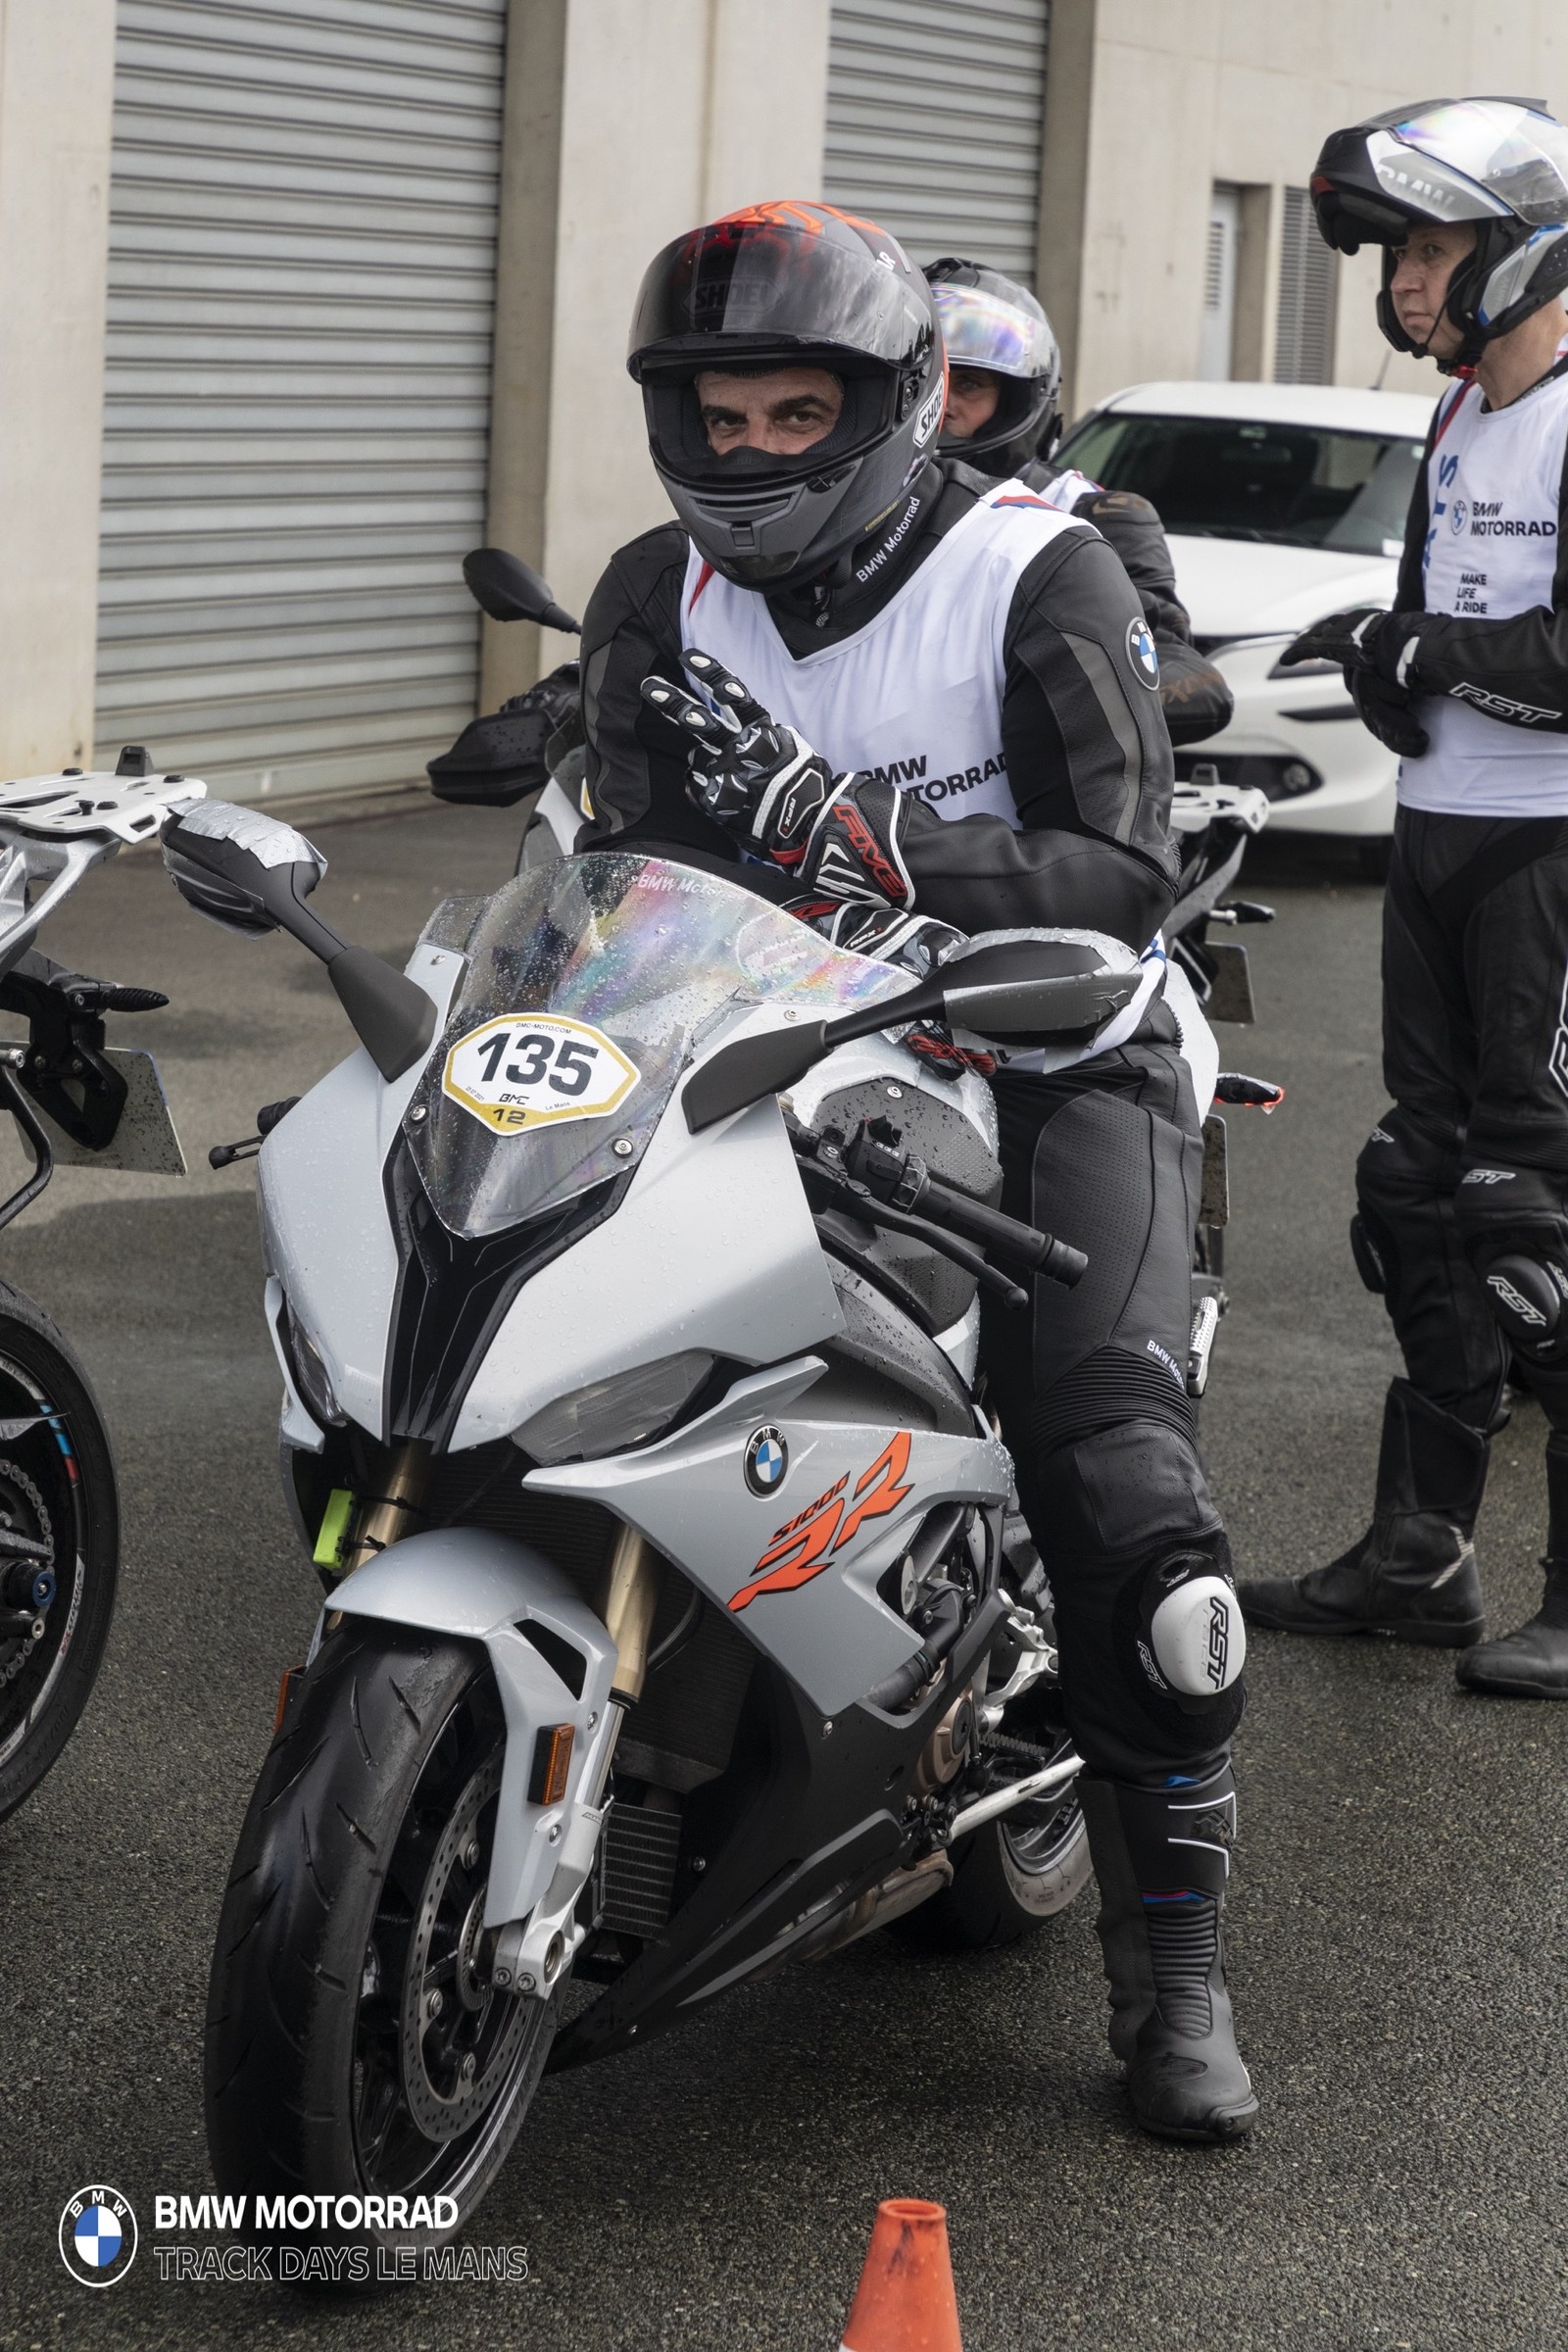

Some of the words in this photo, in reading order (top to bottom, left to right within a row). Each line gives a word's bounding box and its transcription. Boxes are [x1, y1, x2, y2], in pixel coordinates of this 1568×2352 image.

[1472, 501, 1504, 517] BMW
[856, 549, 888, 584] BMW
[885, 495, 921, 553] Motorrad
[1470, 520, 1557, 537] MOTORRAD
[1460, 573, 1488, 587] MAKE
[1456, 587, 1477, 601] LIFE
[1462, 602, 1488, 614] RIDE
[1448, 681, 1564, 724] RST
[833, 804, 907, 898] FIVE
[638, 874, 674, 892] BMW
[477, 1032, 600, 1097] 135
[493, 1108, 526, 1125] 12
[1487, 1276, 1547, 1327] RST
[1147, 1339, 1170, 1361] BMW
[1207, 1595, 1229, 1691] RST
[1136, 1640, 1167, 1690] RST
